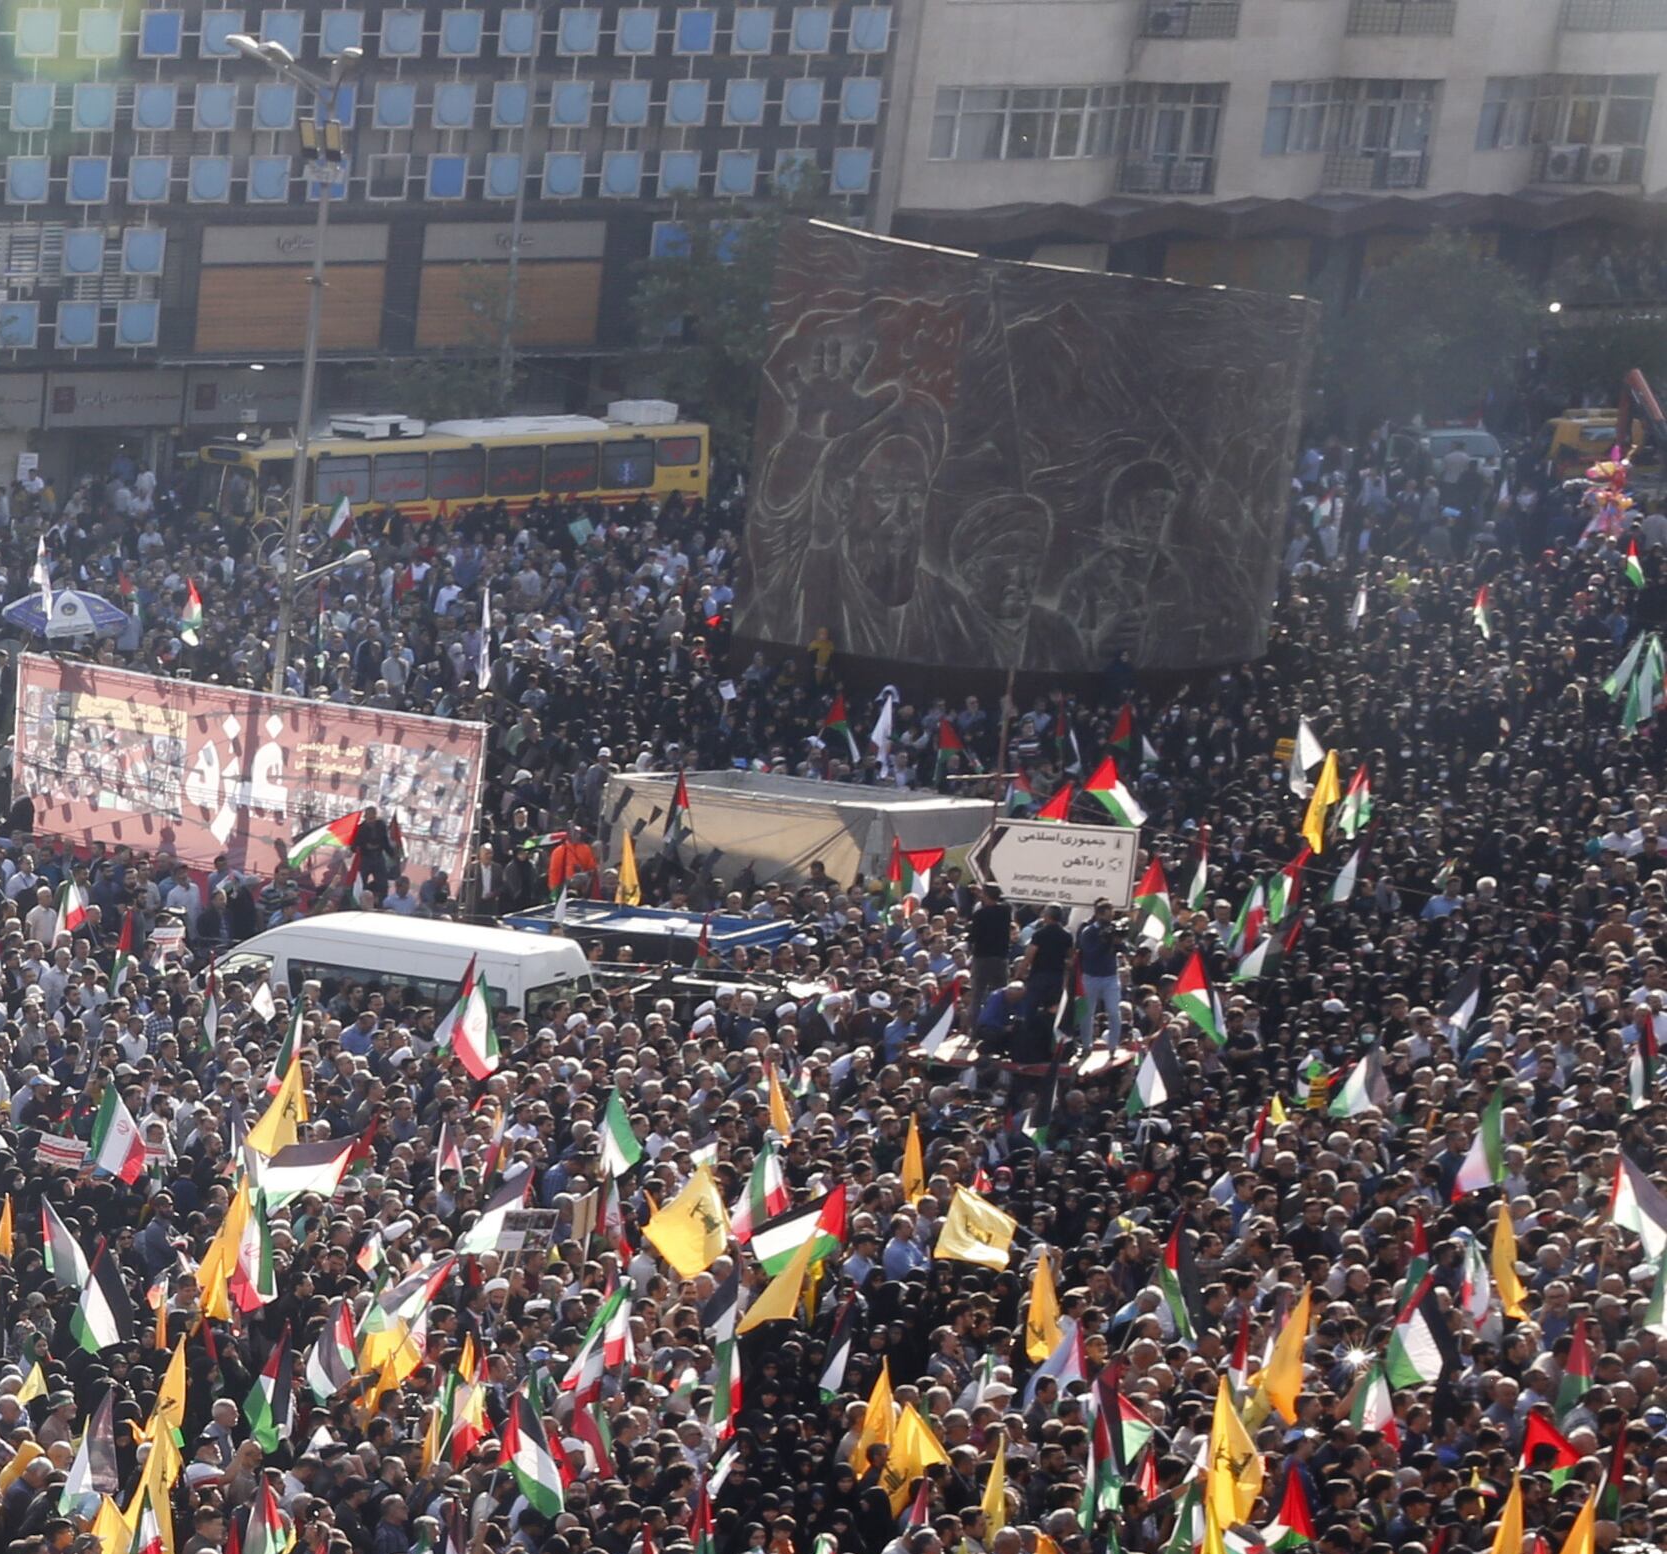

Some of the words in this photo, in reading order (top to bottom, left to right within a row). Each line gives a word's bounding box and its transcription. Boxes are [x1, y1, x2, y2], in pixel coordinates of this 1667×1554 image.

[184, 713, 289, 846] غزه
[1018, 831, 1060, 844] اسلامی
[1011, 872, 1059, 885] Jomhuri-e
[1061, 875, 1093, 887] Eslami
